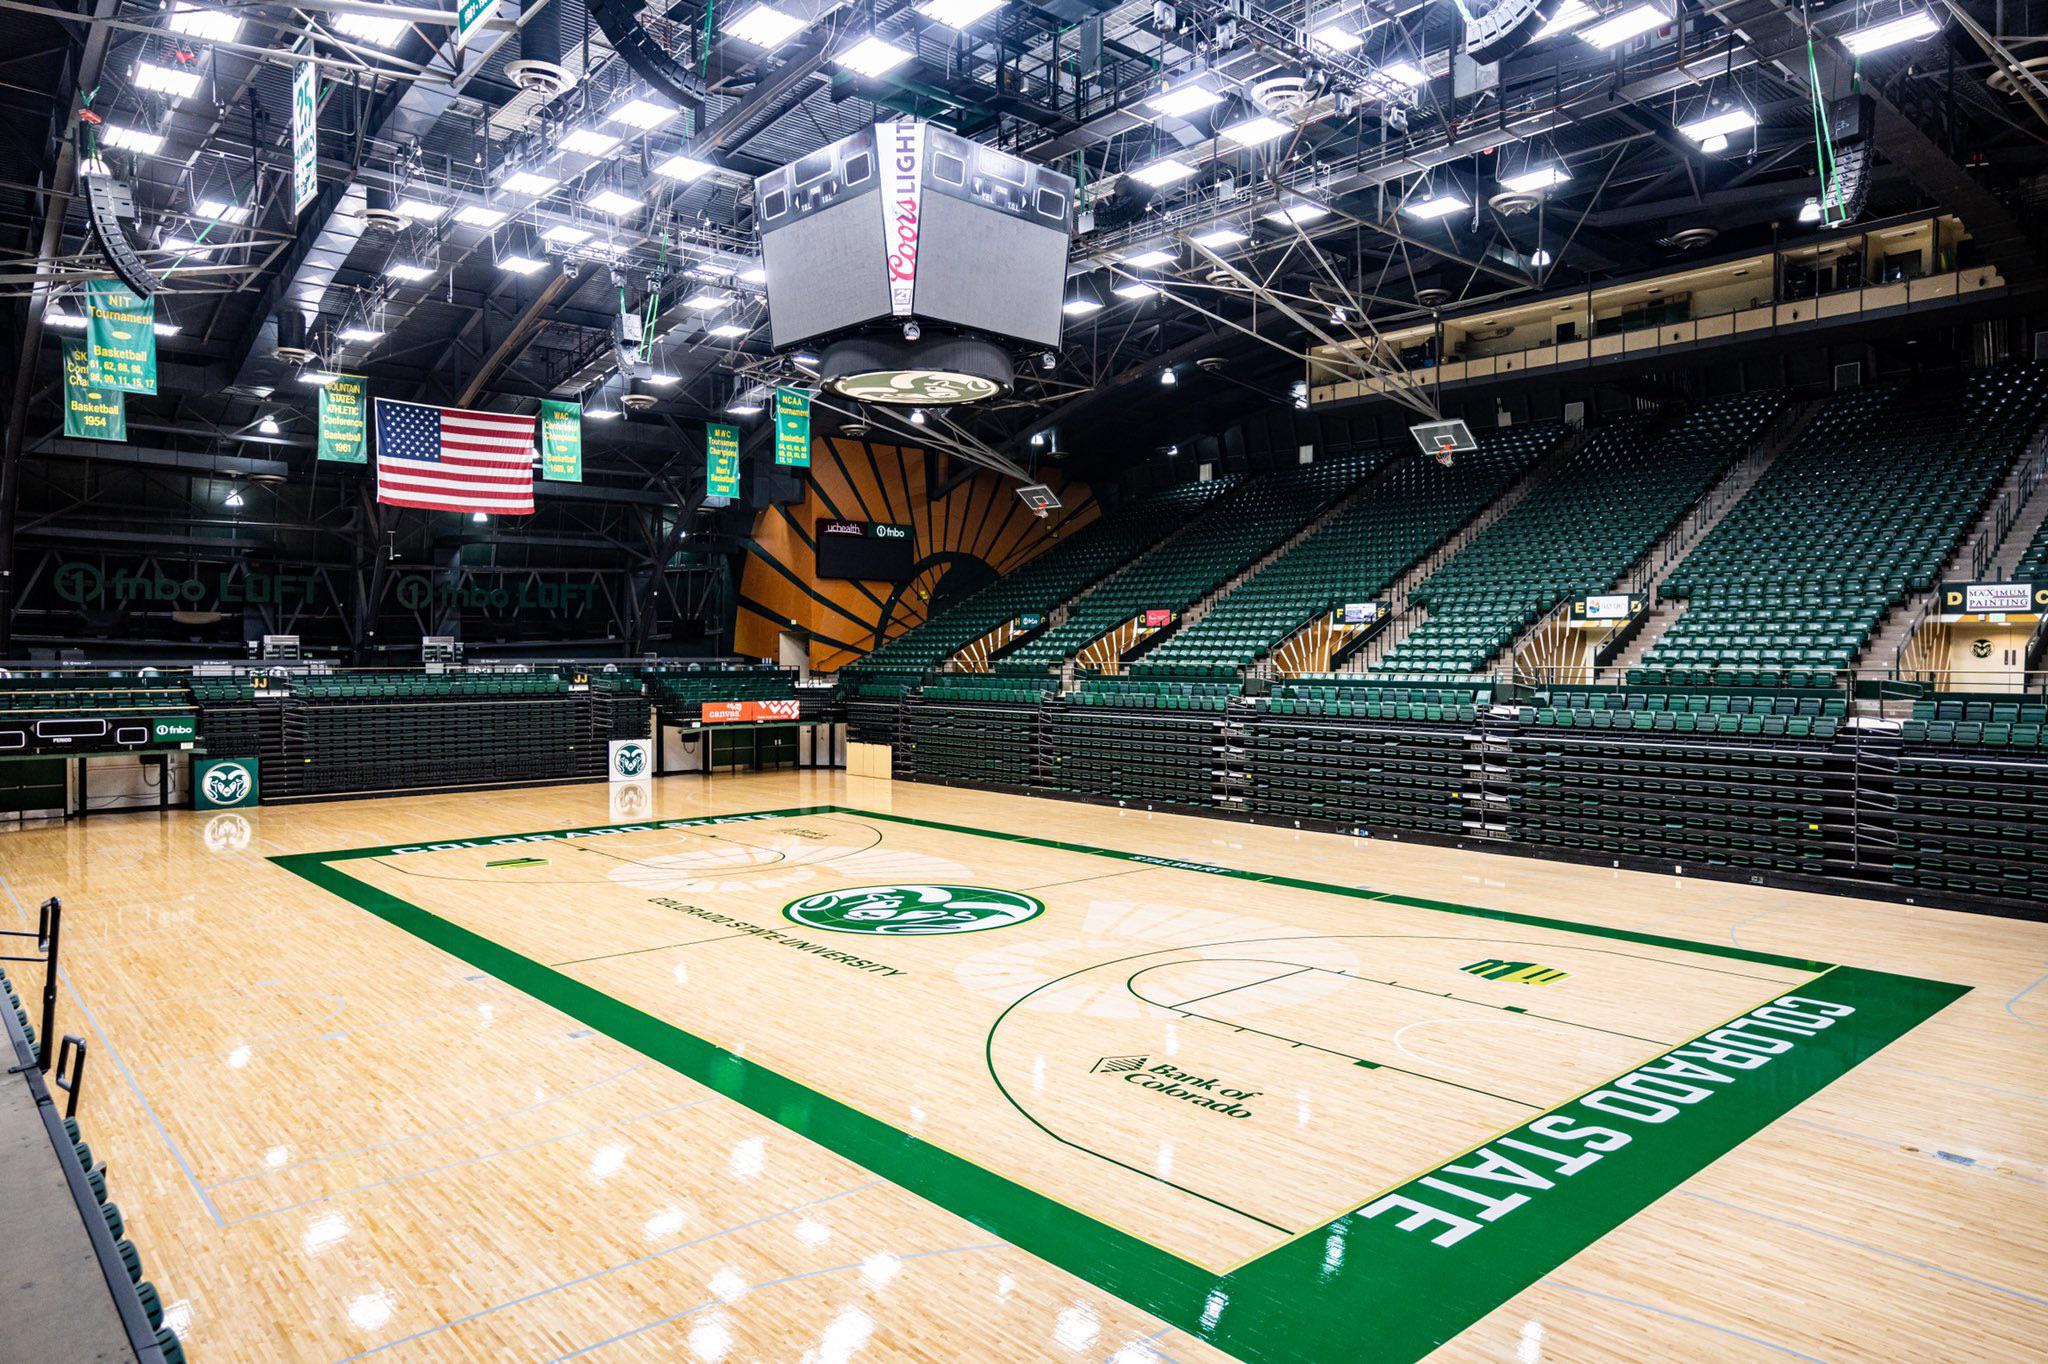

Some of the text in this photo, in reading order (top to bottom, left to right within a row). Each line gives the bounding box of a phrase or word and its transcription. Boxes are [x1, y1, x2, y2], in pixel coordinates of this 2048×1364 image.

[896, 125, 916, 194] LIGHT
[888, 197, 917, 282] Coors
[108, 295, 131, 307] NIT
[88, 305, 153, 326] Tournament
[93, 344, 147, 362] Basketball
[145, 378, 155, 389] 17
[325, 382, 361, 394] MOUNTAIN
[330, 393, 356, 405] STATES
[782, 395, 803, 407] NCAA
[71, 400, 119, 415] Basketball
[327, 404, 360, 416] ATHLETIC
[777, 404, 808, 417] Tournament
[84, 416, 107, 427] 1954
[322, 414, 363, 428] Conference
[554, 411, 569, 420] WAC
[323, 429, 362, 442] Basketball
[780, 433, 805, 444] Basketball
[709, 436, 738, 449] Tournament
[711, 473, 736, 484] Basketball
[827, 522, 861, 534] uchealth
[886, 527, 905, 538] fnbo
[112, 568, 206, 601] fnbo
[219, 572, 317, 605] LOFT
[440, 579, 509, 609] fnbo
[518, 583, 599, 609] LOFT
[1947, 591, 1963, 606] D
[1968, 589, 2027, 597] MAXIMUM
[1574, 601, 1585, 614] E
[1969, 599, 2029, 607] PAINTING
[1139, 614, 1146, 624] G
[1336, 608, 1345, 619] F
[253, 677, 268, 689] JJ
[574, 674, 588, 684] JJ
[169, 725, 193, 734] fnbo
[391, 813, 784, 855] COLORADO STATE
[648, 896, 908, 978] COLORADO STATE UNIVERSITY
[1148, 1063, 1264, 1101] Bank of
[1124, 1073, 1253, 1119] Colorado
[1355, 996, 1857, 1249] COLORADO STATE
